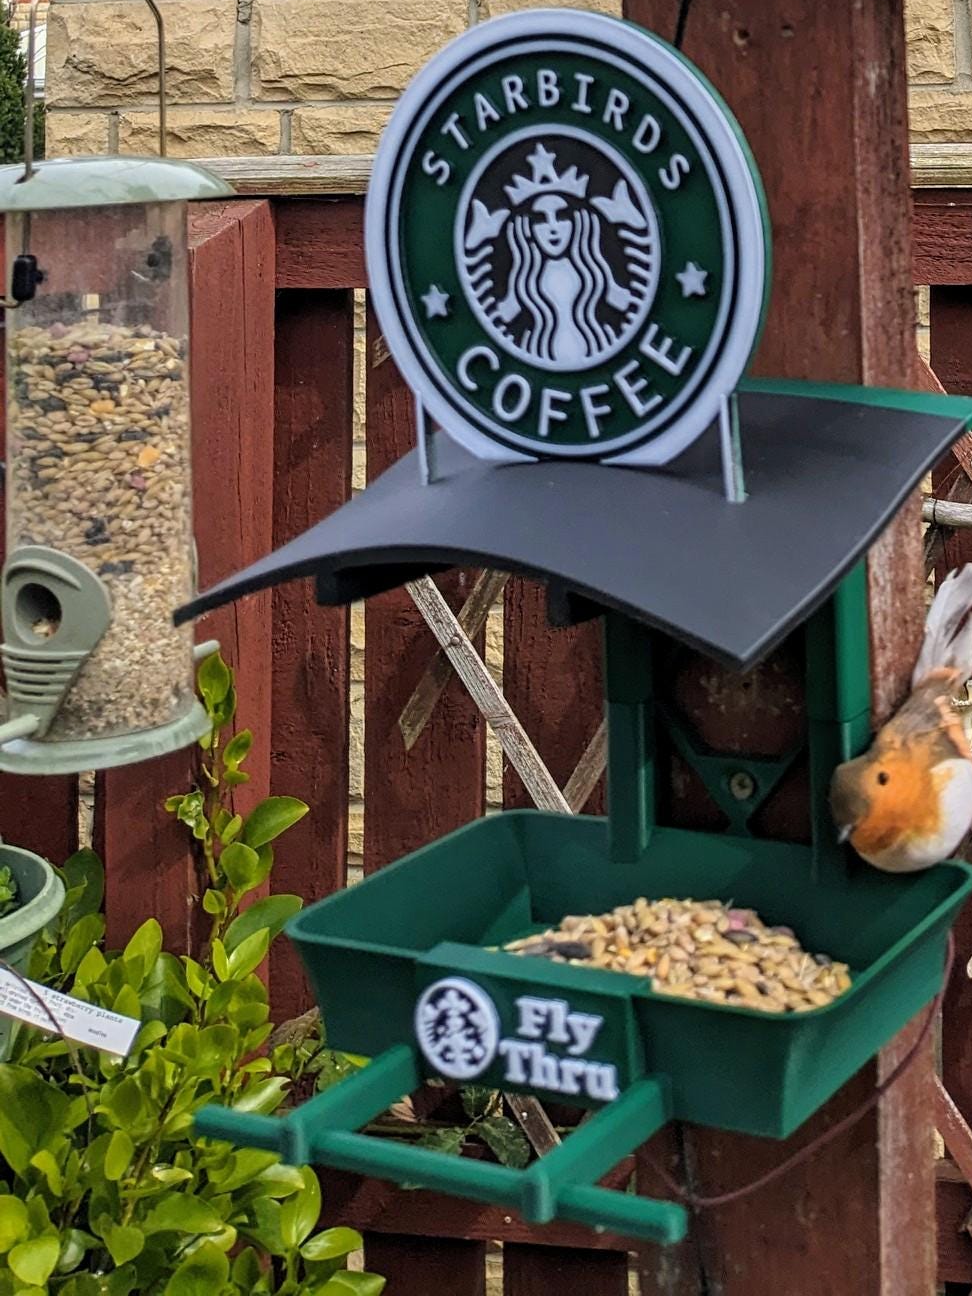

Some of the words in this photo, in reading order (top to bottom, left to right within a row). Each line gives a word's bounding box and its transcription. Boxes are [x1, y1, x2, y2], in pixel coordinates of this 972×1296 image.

[421, 67, 691, 191] STARBIRDS
[456, 324, 692, 438] COFFEE
[499, 1037, 620, 1101] Thru
[515, 995, 603, 1055] Fly
